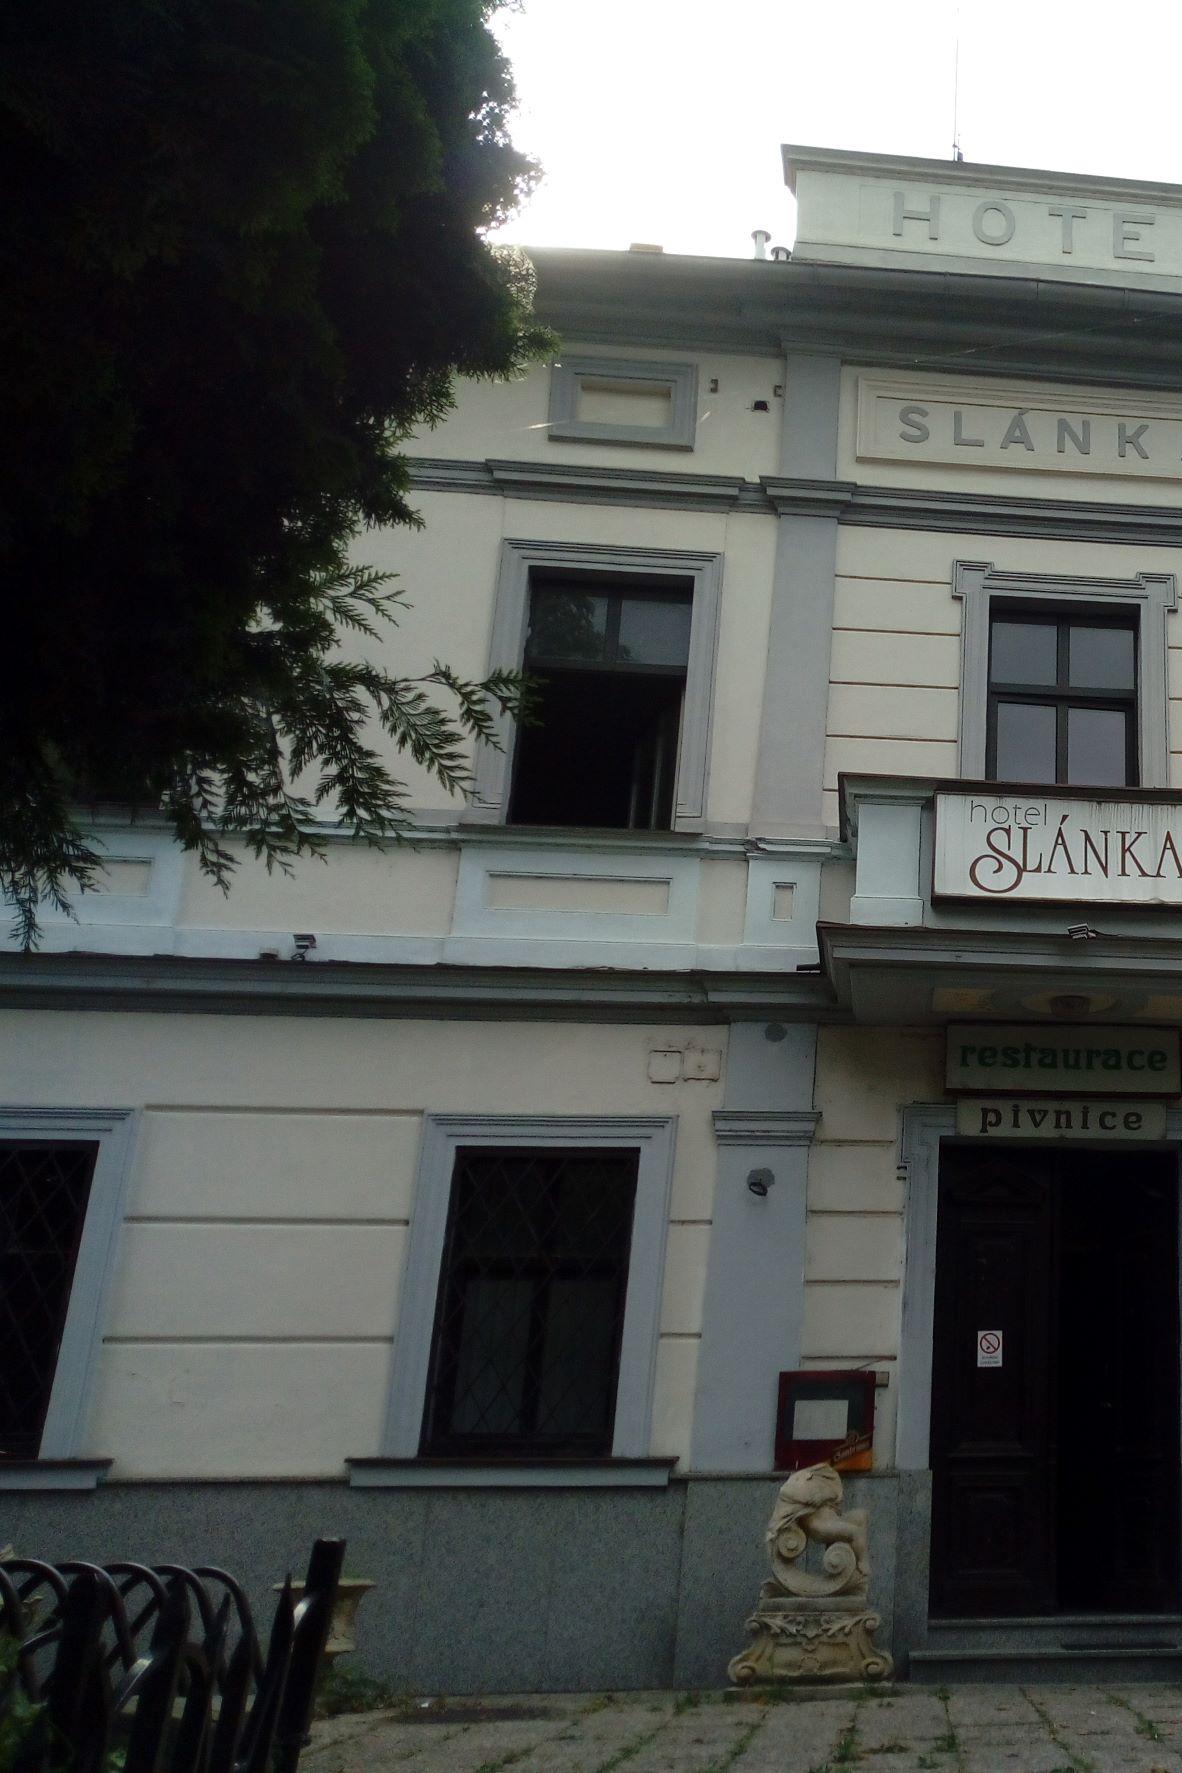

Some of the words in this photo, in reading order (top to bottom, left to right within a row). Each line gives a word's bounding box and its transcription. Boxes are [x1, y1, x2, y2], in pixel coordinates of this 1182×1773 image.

[969, 800, 1048, 827] hotel
[959, 1042, 1169, 1073] restaurace
[980, 1105, 1144, 1134] pivnice
